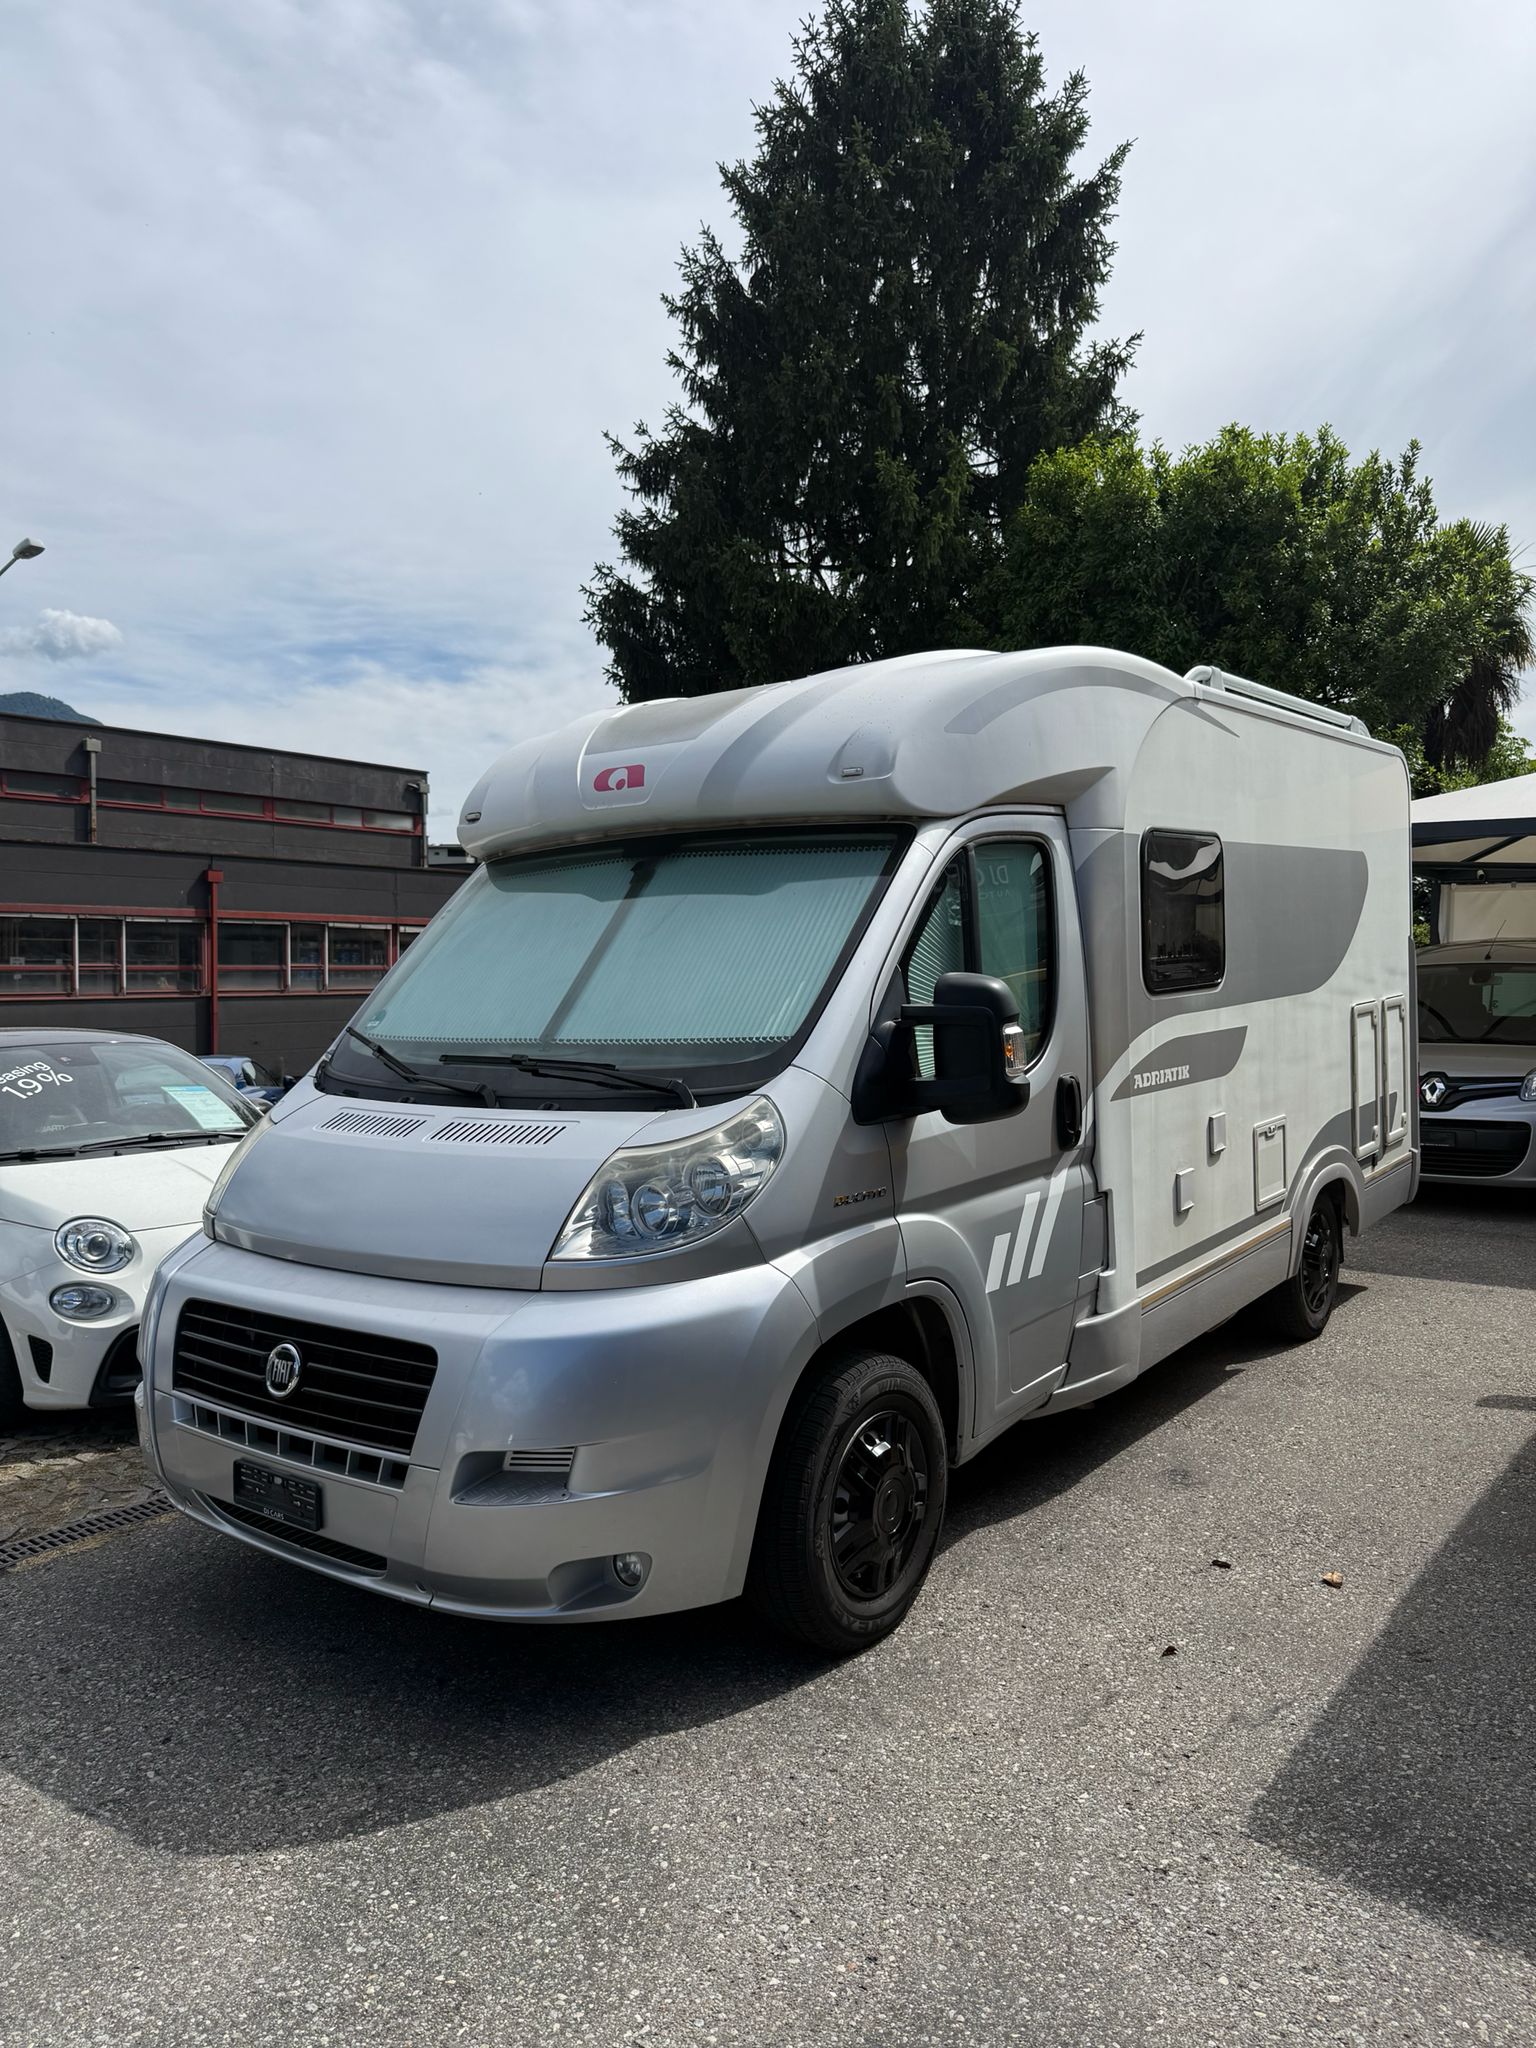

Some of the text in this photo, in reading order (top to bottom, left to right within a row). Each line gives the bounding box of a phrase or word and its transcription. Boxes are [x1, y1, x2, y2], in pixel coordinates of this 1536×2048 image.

[2, 1069, 74, 1099] 1.9%
[1134, 1064, 1190, 1089] ADRIATIK
[272, 1358, 293, 1384] FIAT
